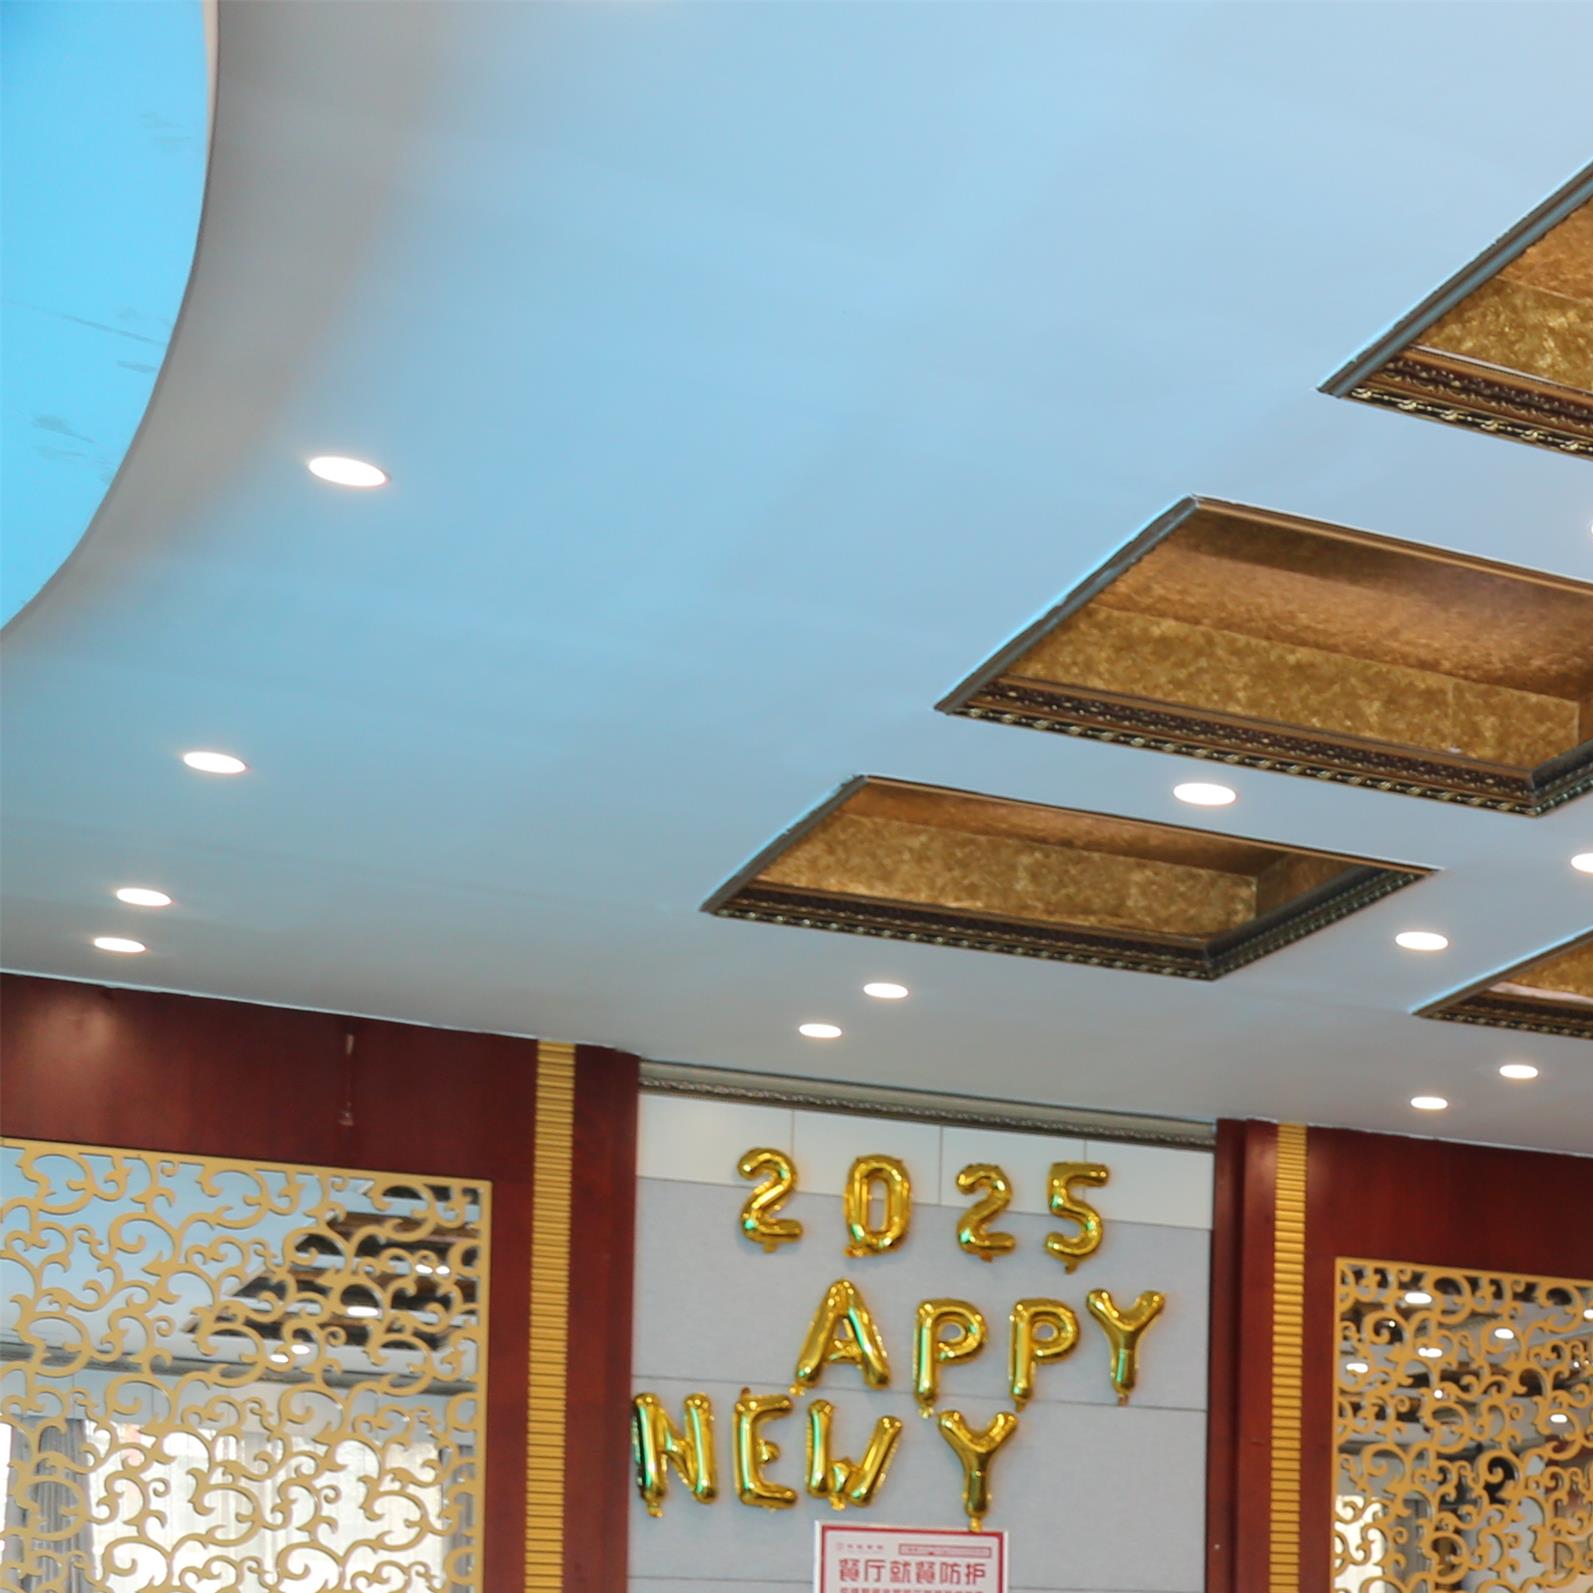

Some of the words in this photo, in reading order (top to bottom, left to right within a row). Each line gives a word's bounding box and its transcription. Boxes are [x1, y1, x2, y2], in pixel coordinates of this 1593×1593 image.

[736, 1147, 1110, 1272] 2025
[791, 1279, 1166, 1408] APPY
[632, 1391, 902, 1514] NEW
[937, 1410, 1018, 1531] Y
[839, 1558, 987, 1585] 餐厅就餐防护
